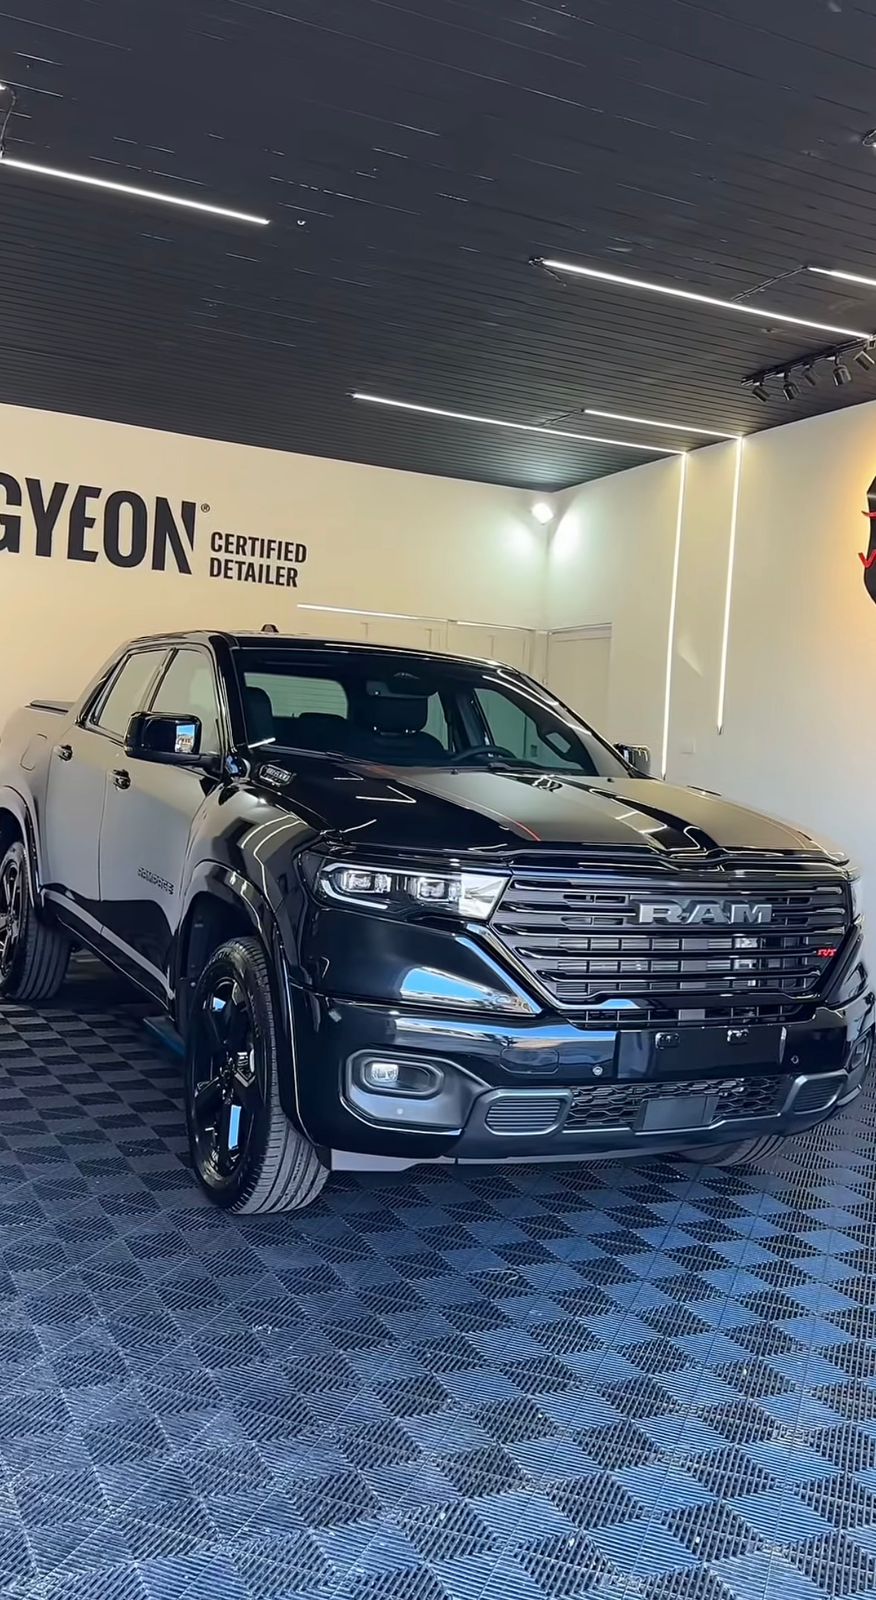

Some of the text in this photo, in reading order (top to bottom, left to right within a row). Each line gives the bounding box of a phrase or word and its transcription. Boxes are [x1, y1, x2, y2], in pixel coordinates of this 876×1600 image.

[210, 531, 307, 563] CERTIFIED
[209, 557, 298, 588] DETAILER
[636, 901, 773, 925] RAM
